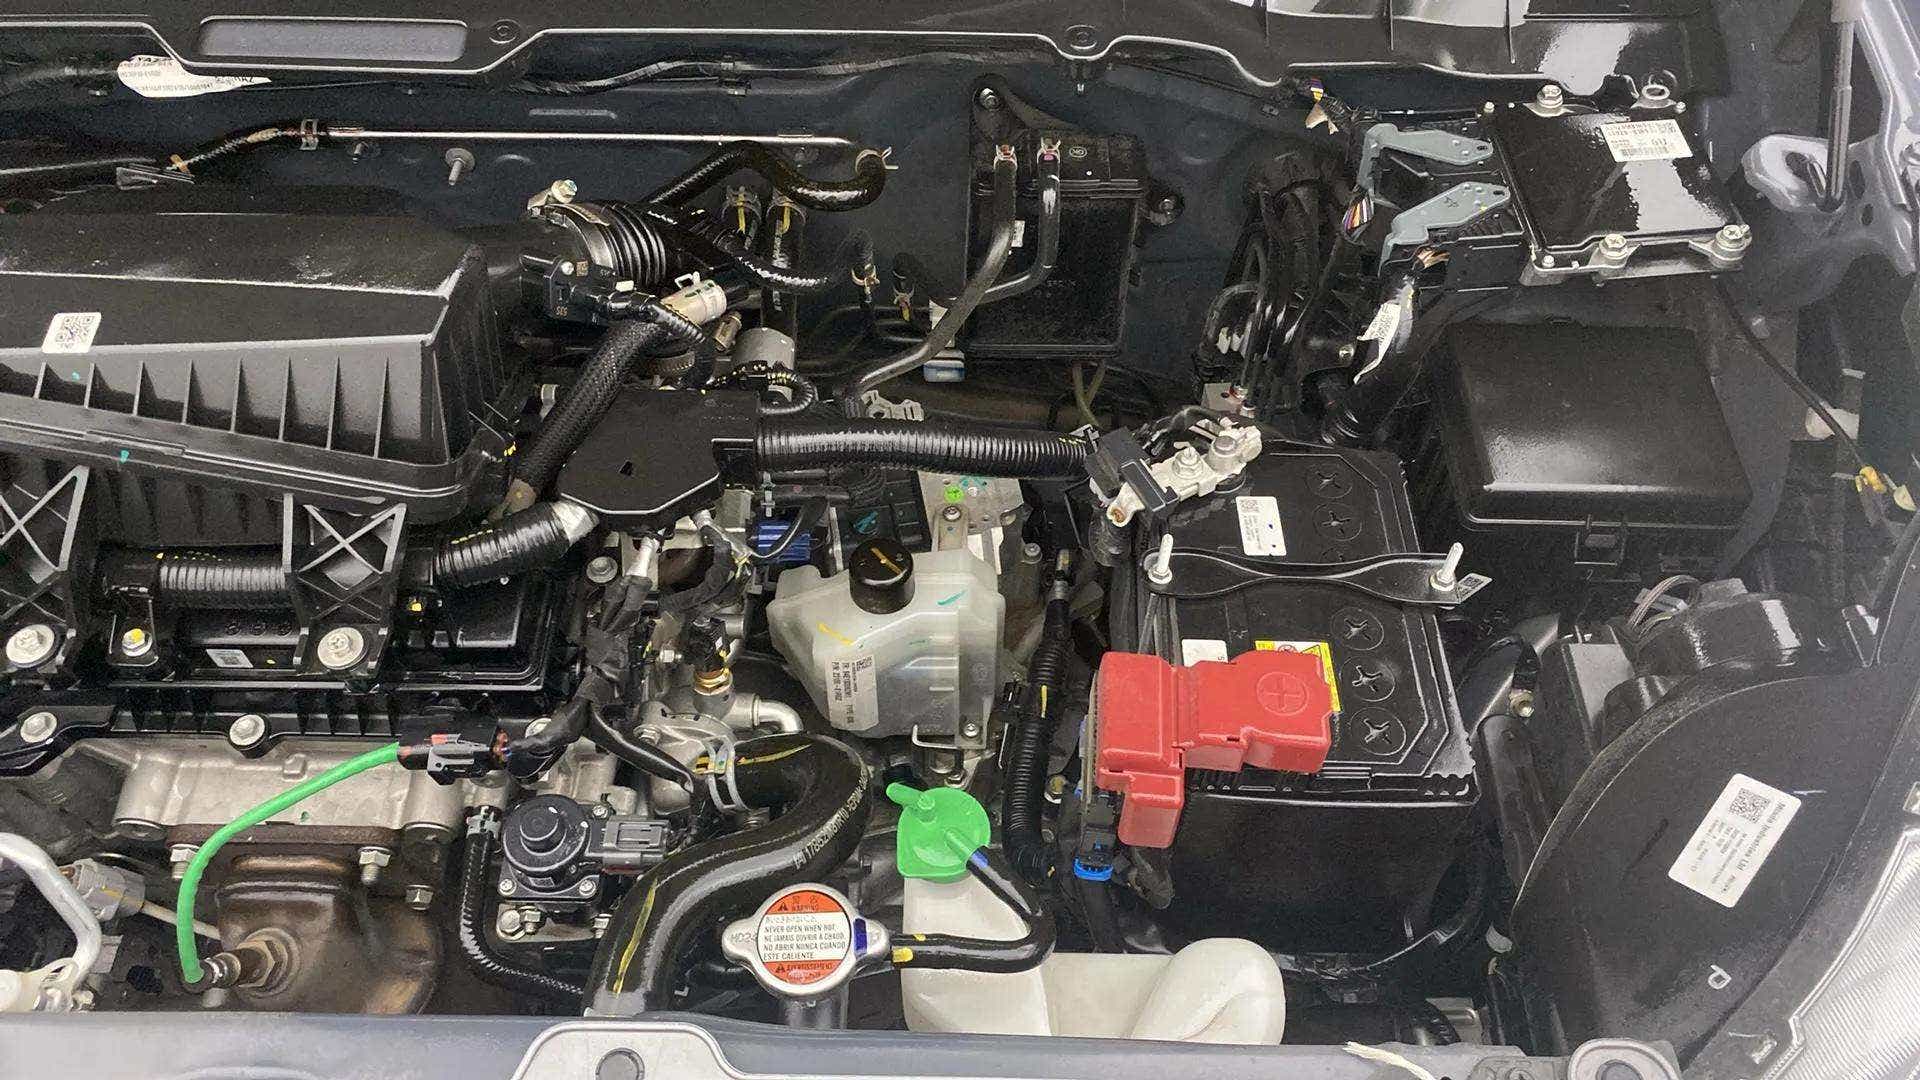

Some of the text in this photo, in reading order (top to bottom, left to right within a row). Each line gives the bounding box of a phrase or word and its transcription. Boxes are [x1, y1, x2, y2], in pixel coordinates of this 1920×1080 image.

[774, 934, 795, 942] JAMAIS
[796, 933, 818, 941] OUVRIR
[775, 943, 795, 951] ABRIR
